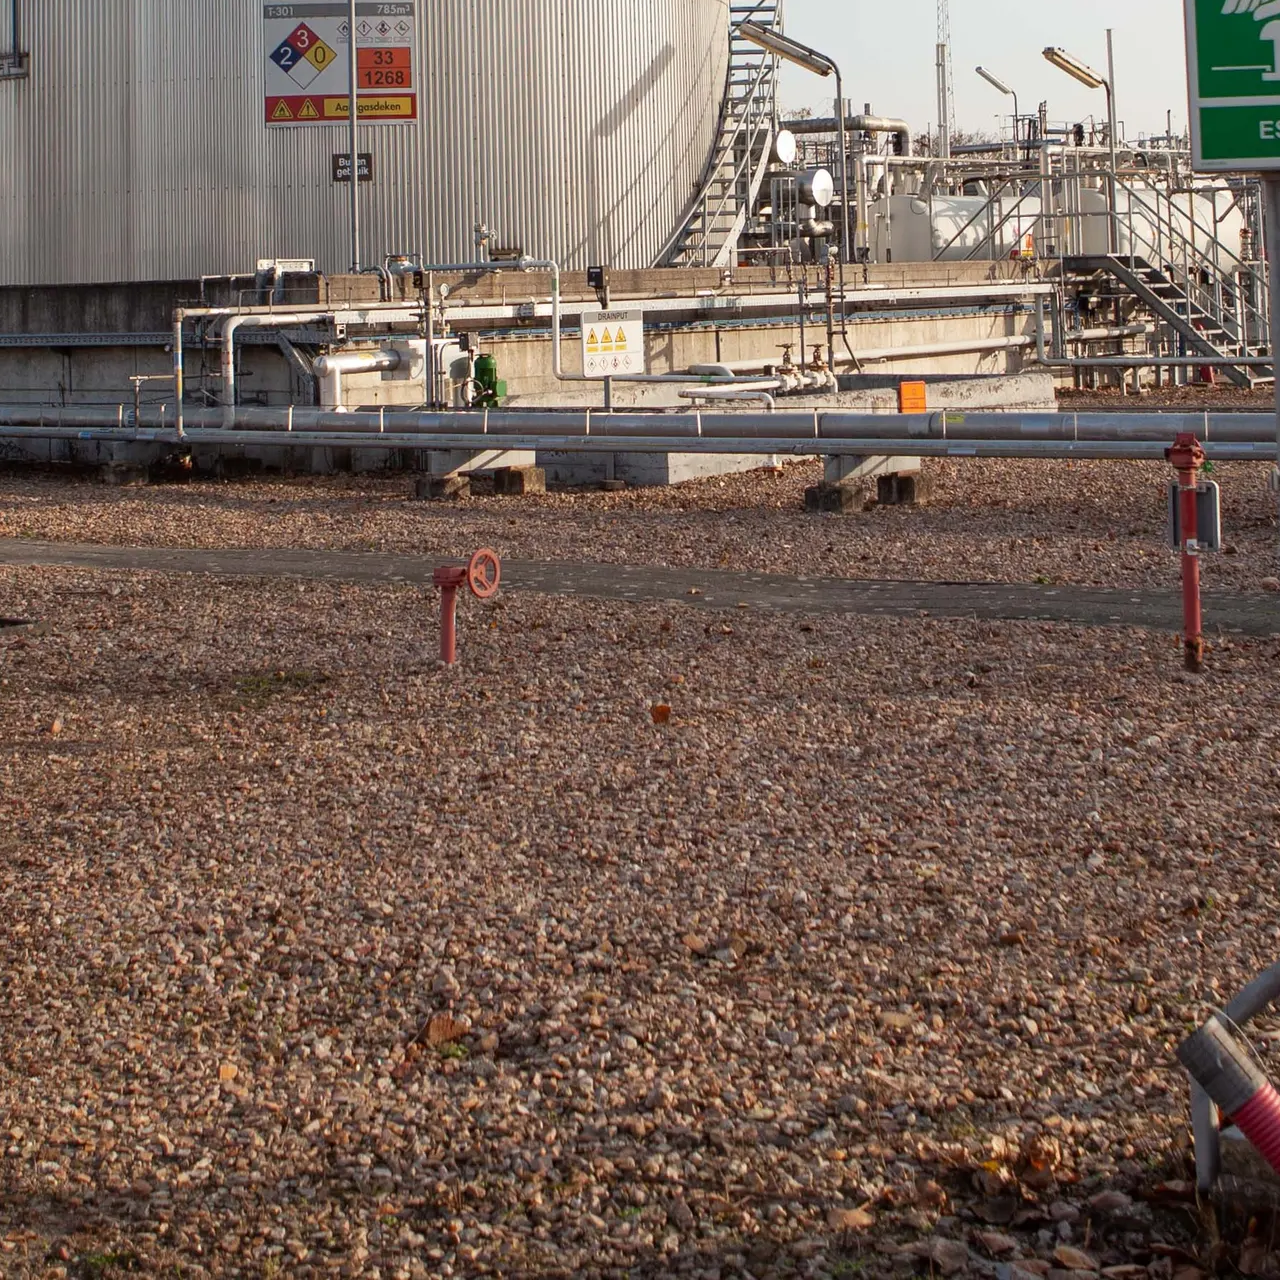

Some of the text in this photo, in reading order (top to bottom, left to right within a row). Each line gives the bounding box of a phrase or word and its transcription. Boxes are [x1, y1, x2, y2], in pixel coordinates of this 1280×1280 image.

[269, 7, 294, 16] T-301
[297, 30, 309, 48] 3
[280, 47, 293, 65] 2
[314, 46, 326, 64] 0
[374, 51, 393, 65] 33
[365, 70, 404, 85] 1268
[335, 101, 401, 113] Aagasdeken
[339, 158, 366, 166] Buen
[597, 312, 628, 320] DRAINPUT
